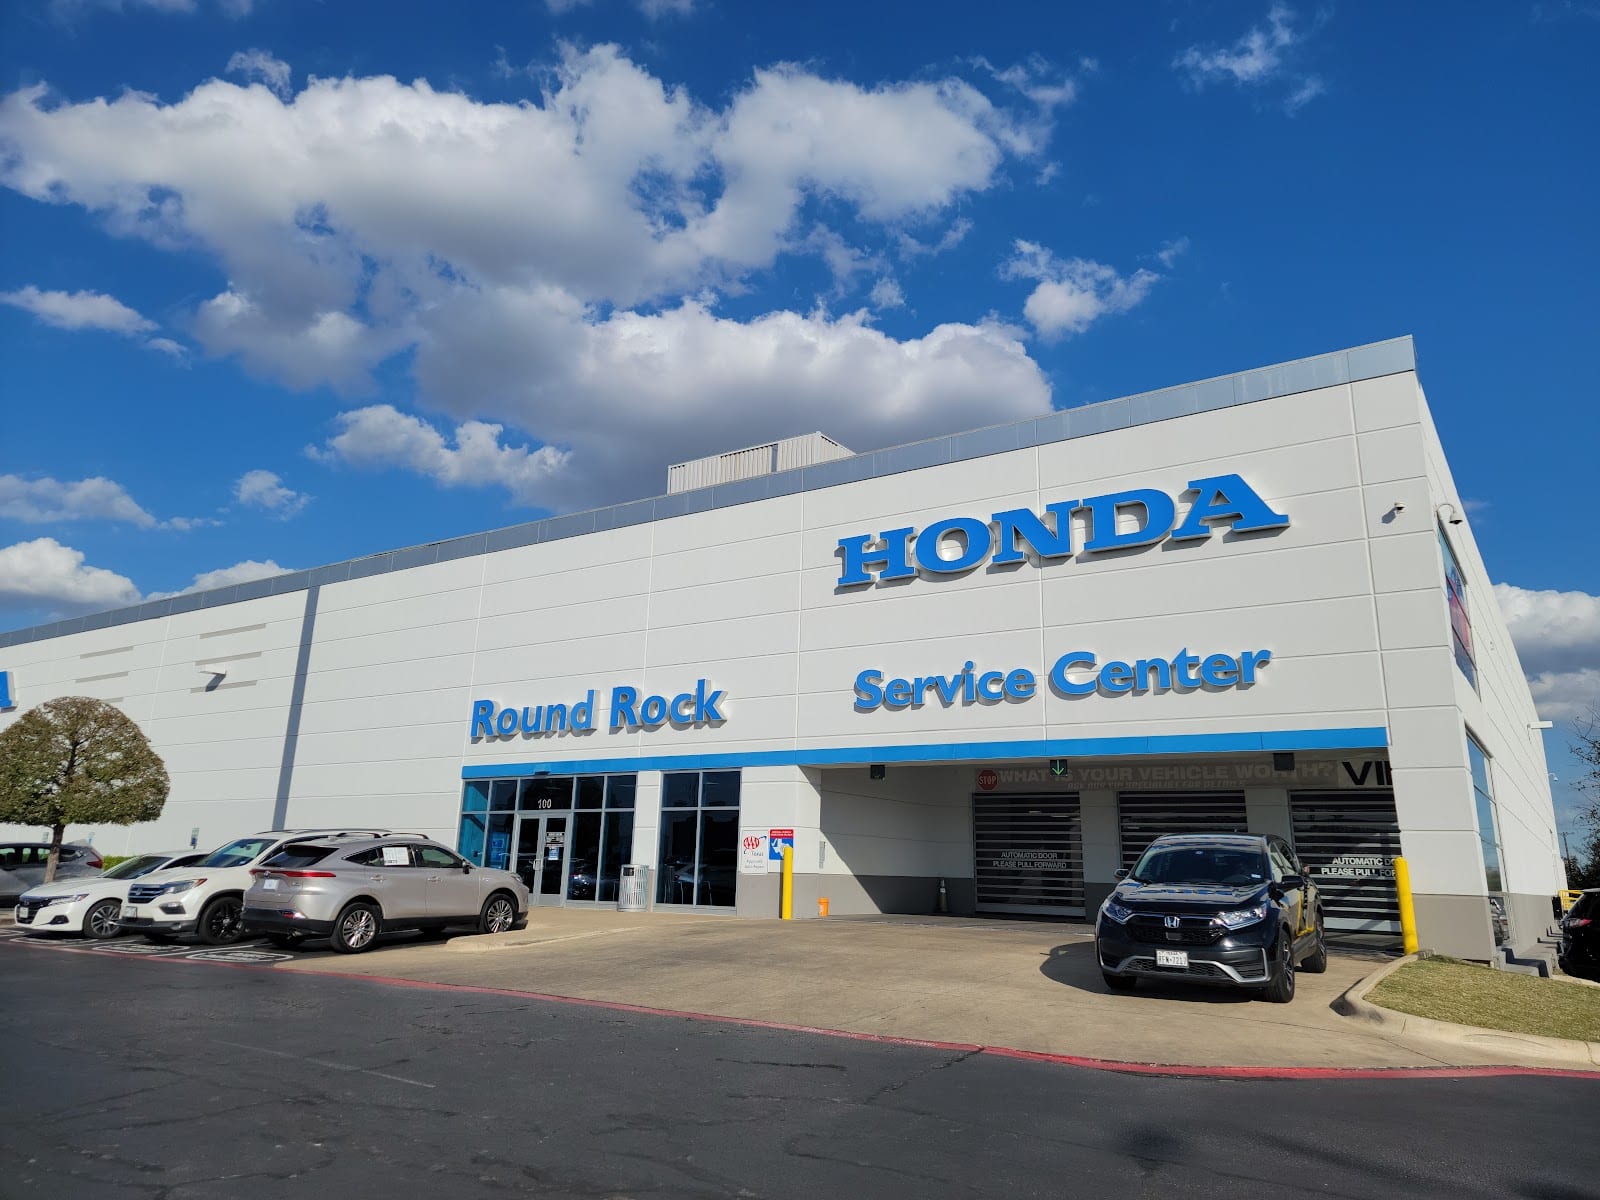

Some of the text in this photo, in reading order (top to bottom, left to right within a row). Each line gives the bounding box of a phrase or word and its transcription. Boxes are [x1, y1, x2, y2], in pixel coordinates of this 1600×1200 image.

[837, 473, 1289, 588] HONDA
[854, 647, 1272, 711] Service Center
[470, 678, 726, 740] Round Rock
[999, 769, 1048, 783] WHAT
[1077, 767, 1132, 781] YOUR
[1137, 766, 1228, 781] VEHICLE
[979, 775, 997, 785] STOP
[537, 798, 552, 809] 100
[1001, 851, 1037, 859] AUTOMATIC
[992, 860, 1016, 868] PLEASE
[1332, 857, 1383, 866] AUTOMATIC
[1321, 867, 1354, 876] PLEASE
[1355, 868, 1375, 876] PULL
